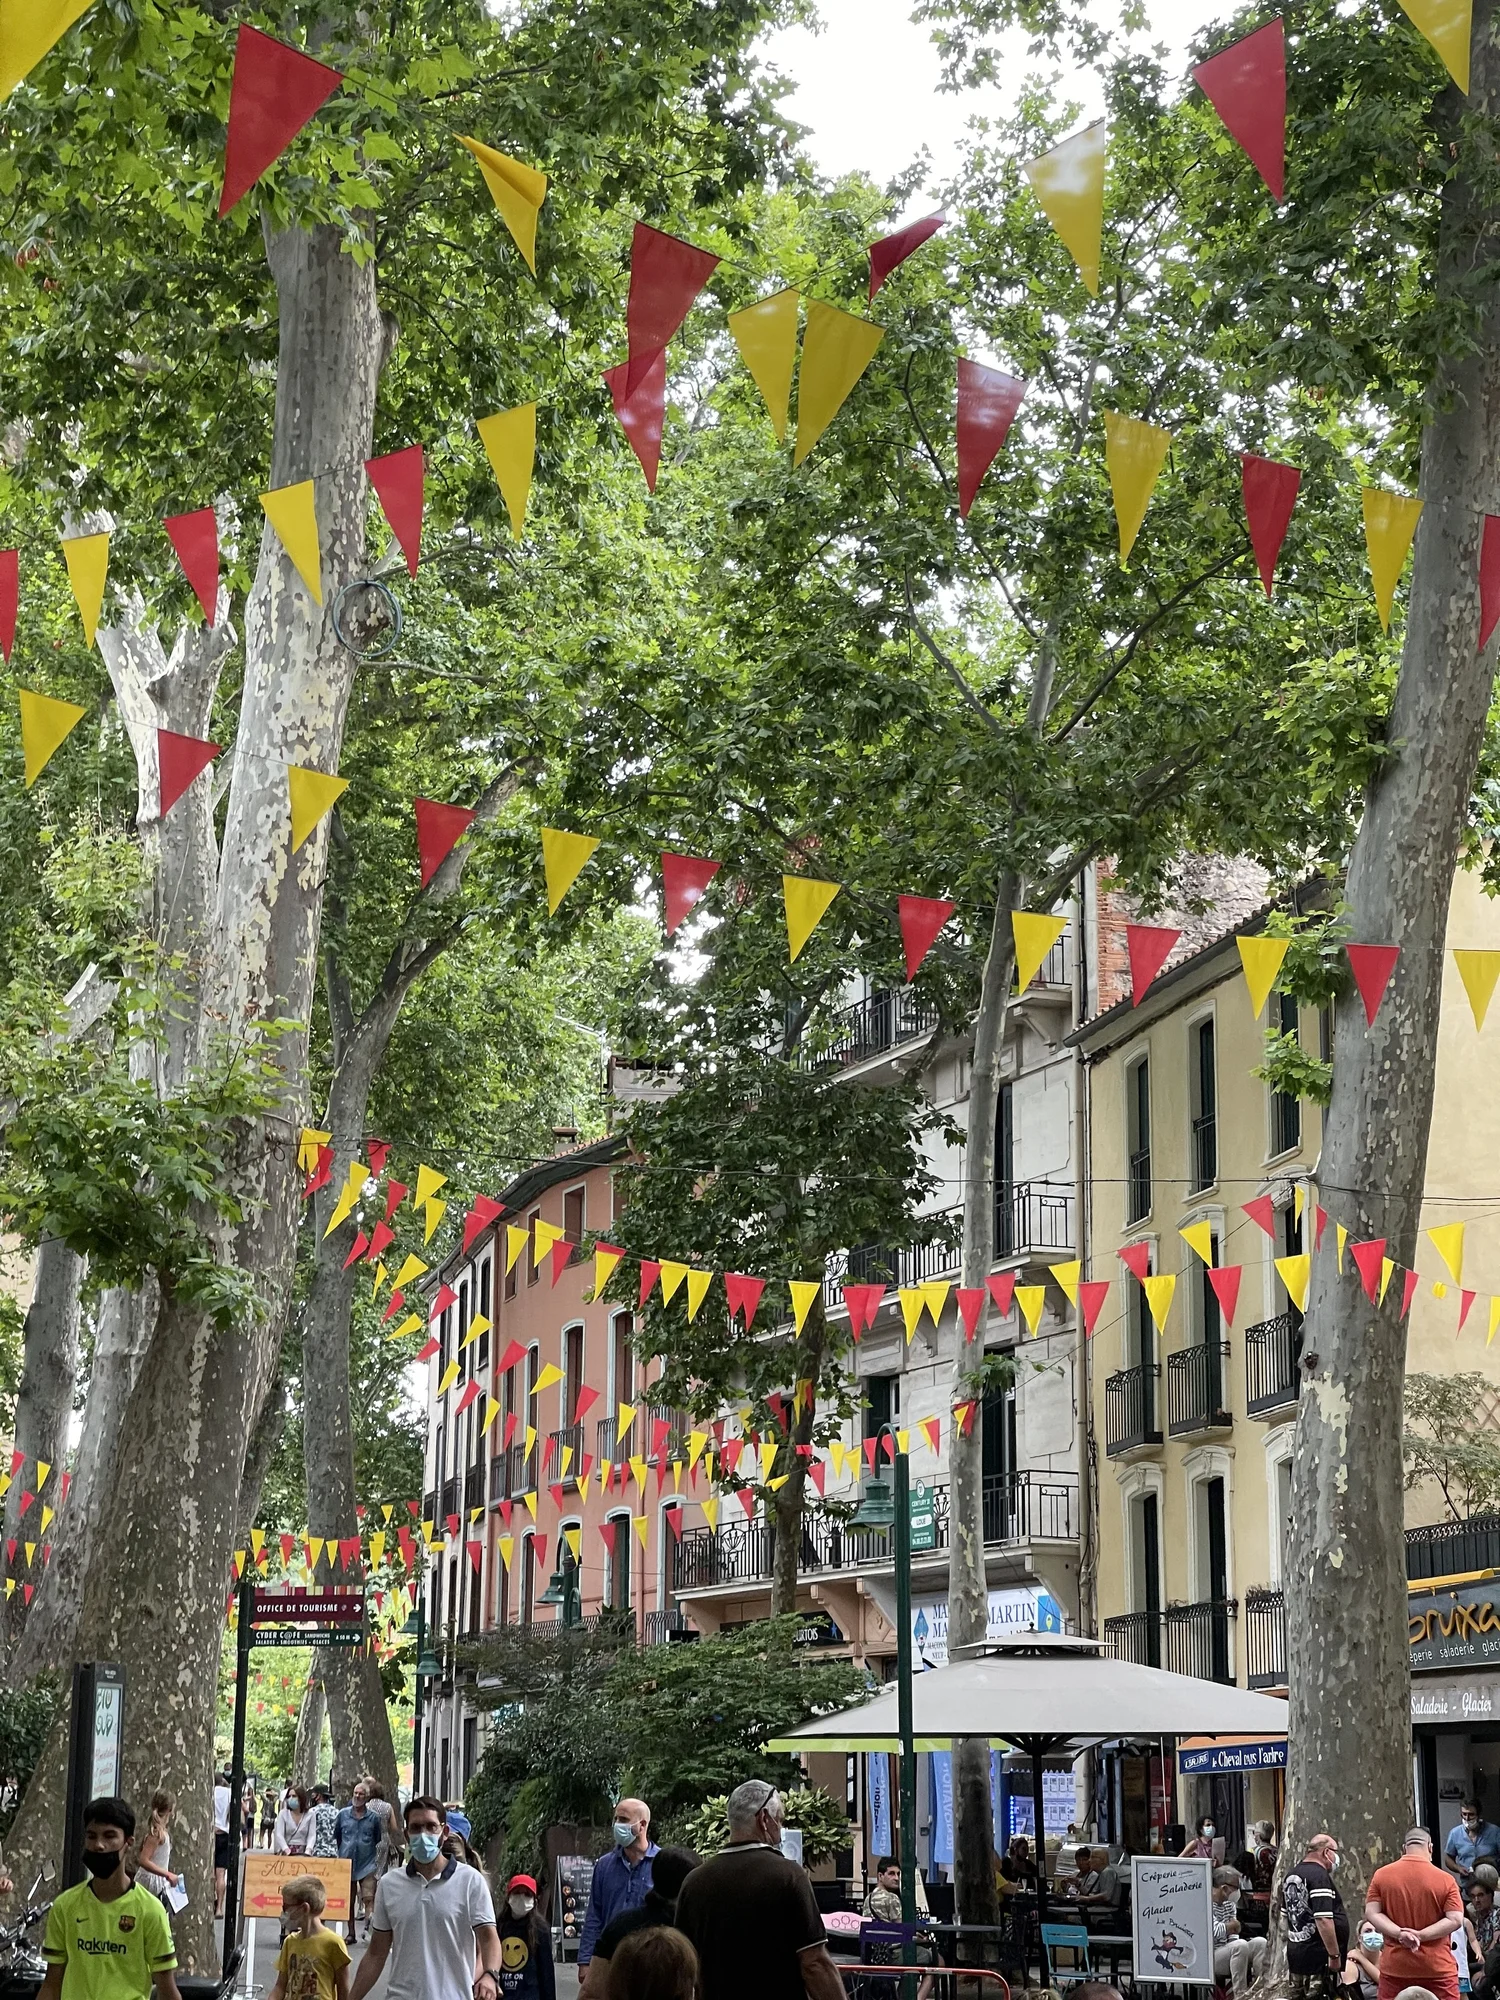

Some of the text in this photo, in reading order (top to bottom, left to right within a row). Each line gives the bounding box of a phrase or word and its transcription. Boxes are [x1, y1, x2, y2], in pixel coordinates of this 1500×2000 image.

[257, 1604, 338, 1613] OFFICE DE TOURISME
[255, 1631, 277, 1639] CYBER
[1439, 1642, 1475, 1658] saladerie
[1482, 1638, 1500, 1656] glaci
[1410, 1694, 1448, 1715] Saladerie
[1461, 1692, 1492, 1717] Glacier
[1218, 1750, 1242, 1767] Cheval
[1141, 1870, 1177, 1883] Crêperie
[1159, 1881, 1203, 1898] Saladerie
[1142, 1905, 1174, 1919] Glacier
[77, 1937, 127, 1955] Rakuten
